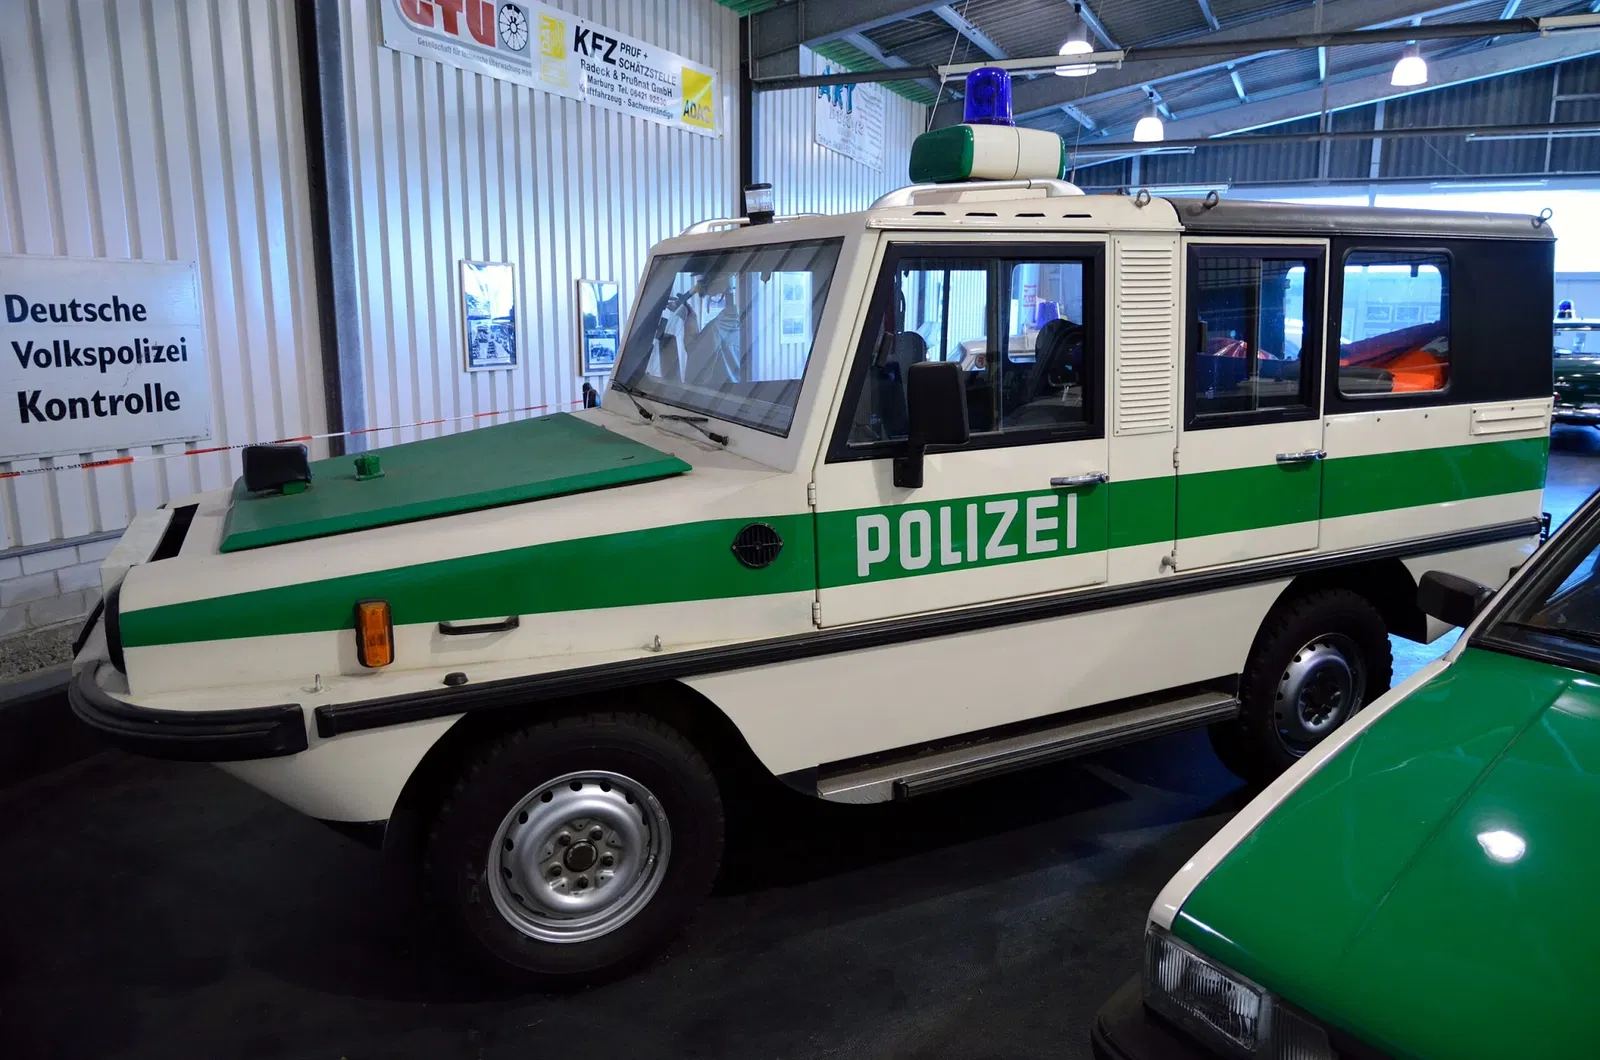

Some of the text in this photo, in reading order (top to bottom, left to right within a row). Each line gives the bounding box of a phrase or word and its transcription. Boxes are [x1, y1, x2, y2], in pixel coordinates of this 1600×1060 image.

[417, 37, 452, 54] Gesellschaft
[573, 25, 618, 65] KFZ
[580, 58, 673, 98] Radeck & Prußnat GmbH
[587, 74, 615, 93] Marburg
[618, 57, 677, 86] SCHÄTZSTELLE
[627, 98, 674, 120] Sachverständige
[683, 99, 711, 124] ADAC
[4, 294, 147, 323] Deutsche
[10, 336, 188, 374] Volkspolizei
[17, 382, 181, 424] Kontrolle
[856, 493, 1078, 577] POLIZEI
